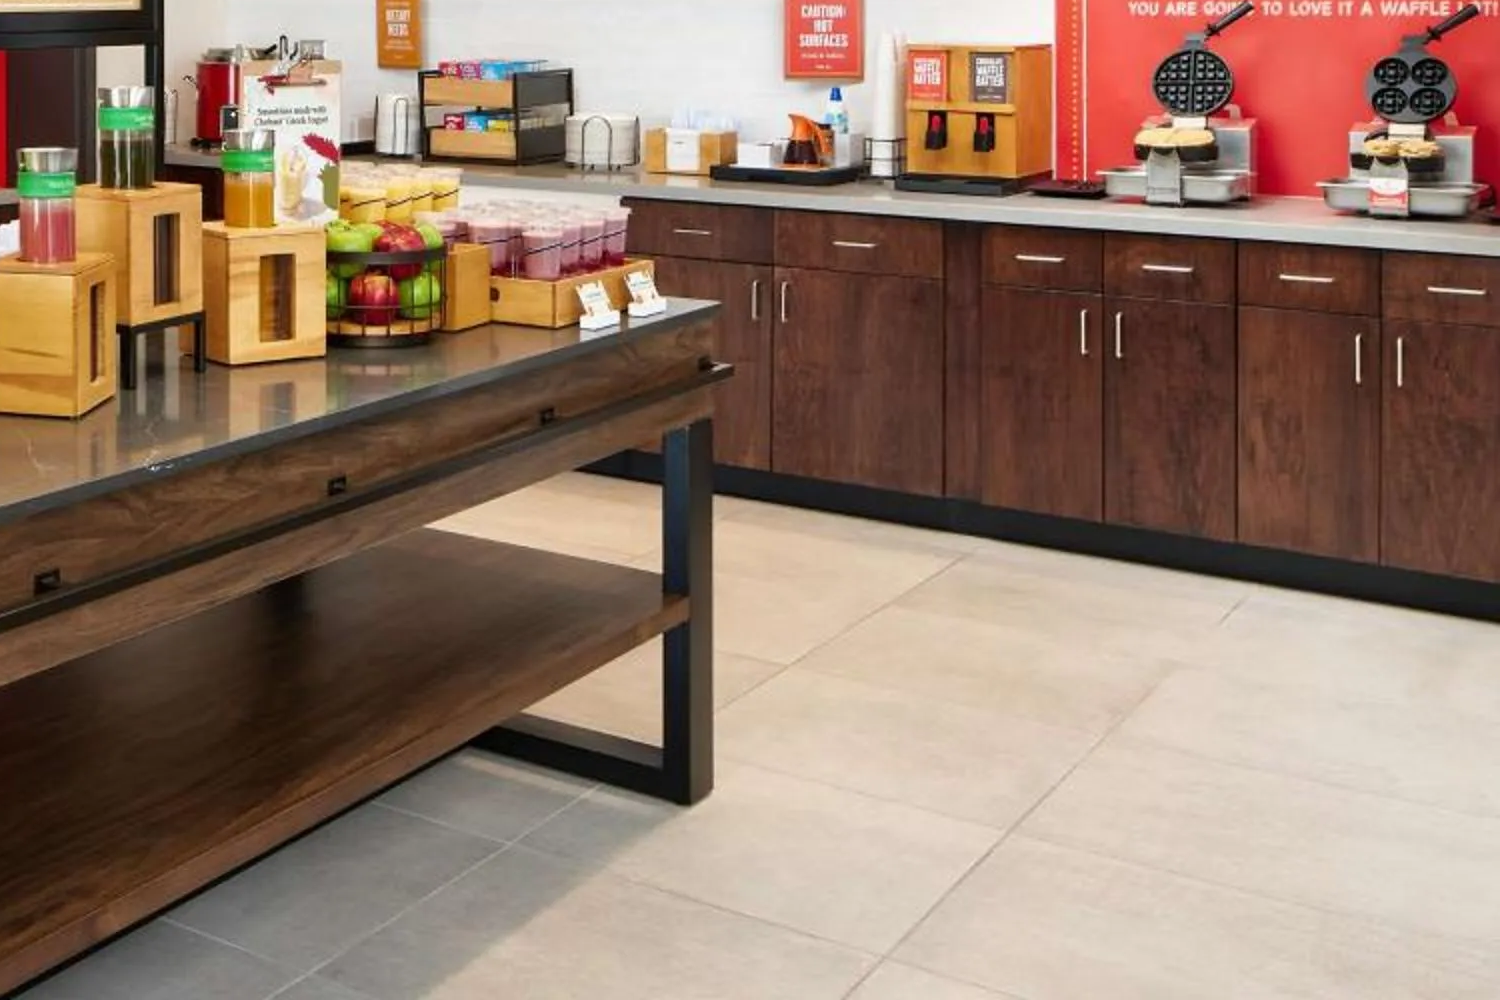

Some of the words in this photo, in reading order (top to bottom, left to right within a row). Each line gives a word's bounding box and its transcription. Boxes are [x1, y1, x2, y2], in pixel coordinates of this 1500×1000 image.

[1128, 1, 1159, 17] YOU
[1165, 0, 1197, 17] ARE
[1203, 0, 1253, 17] GOI
[1261, 0, 1283, 16] TO
[1289, 0, 1332, 16] LOVE
[1338, 0, 1354, 16] IT
[1360, 0, 1373, 16] A
[1380, 0, 1451, 17] WAFFLE
